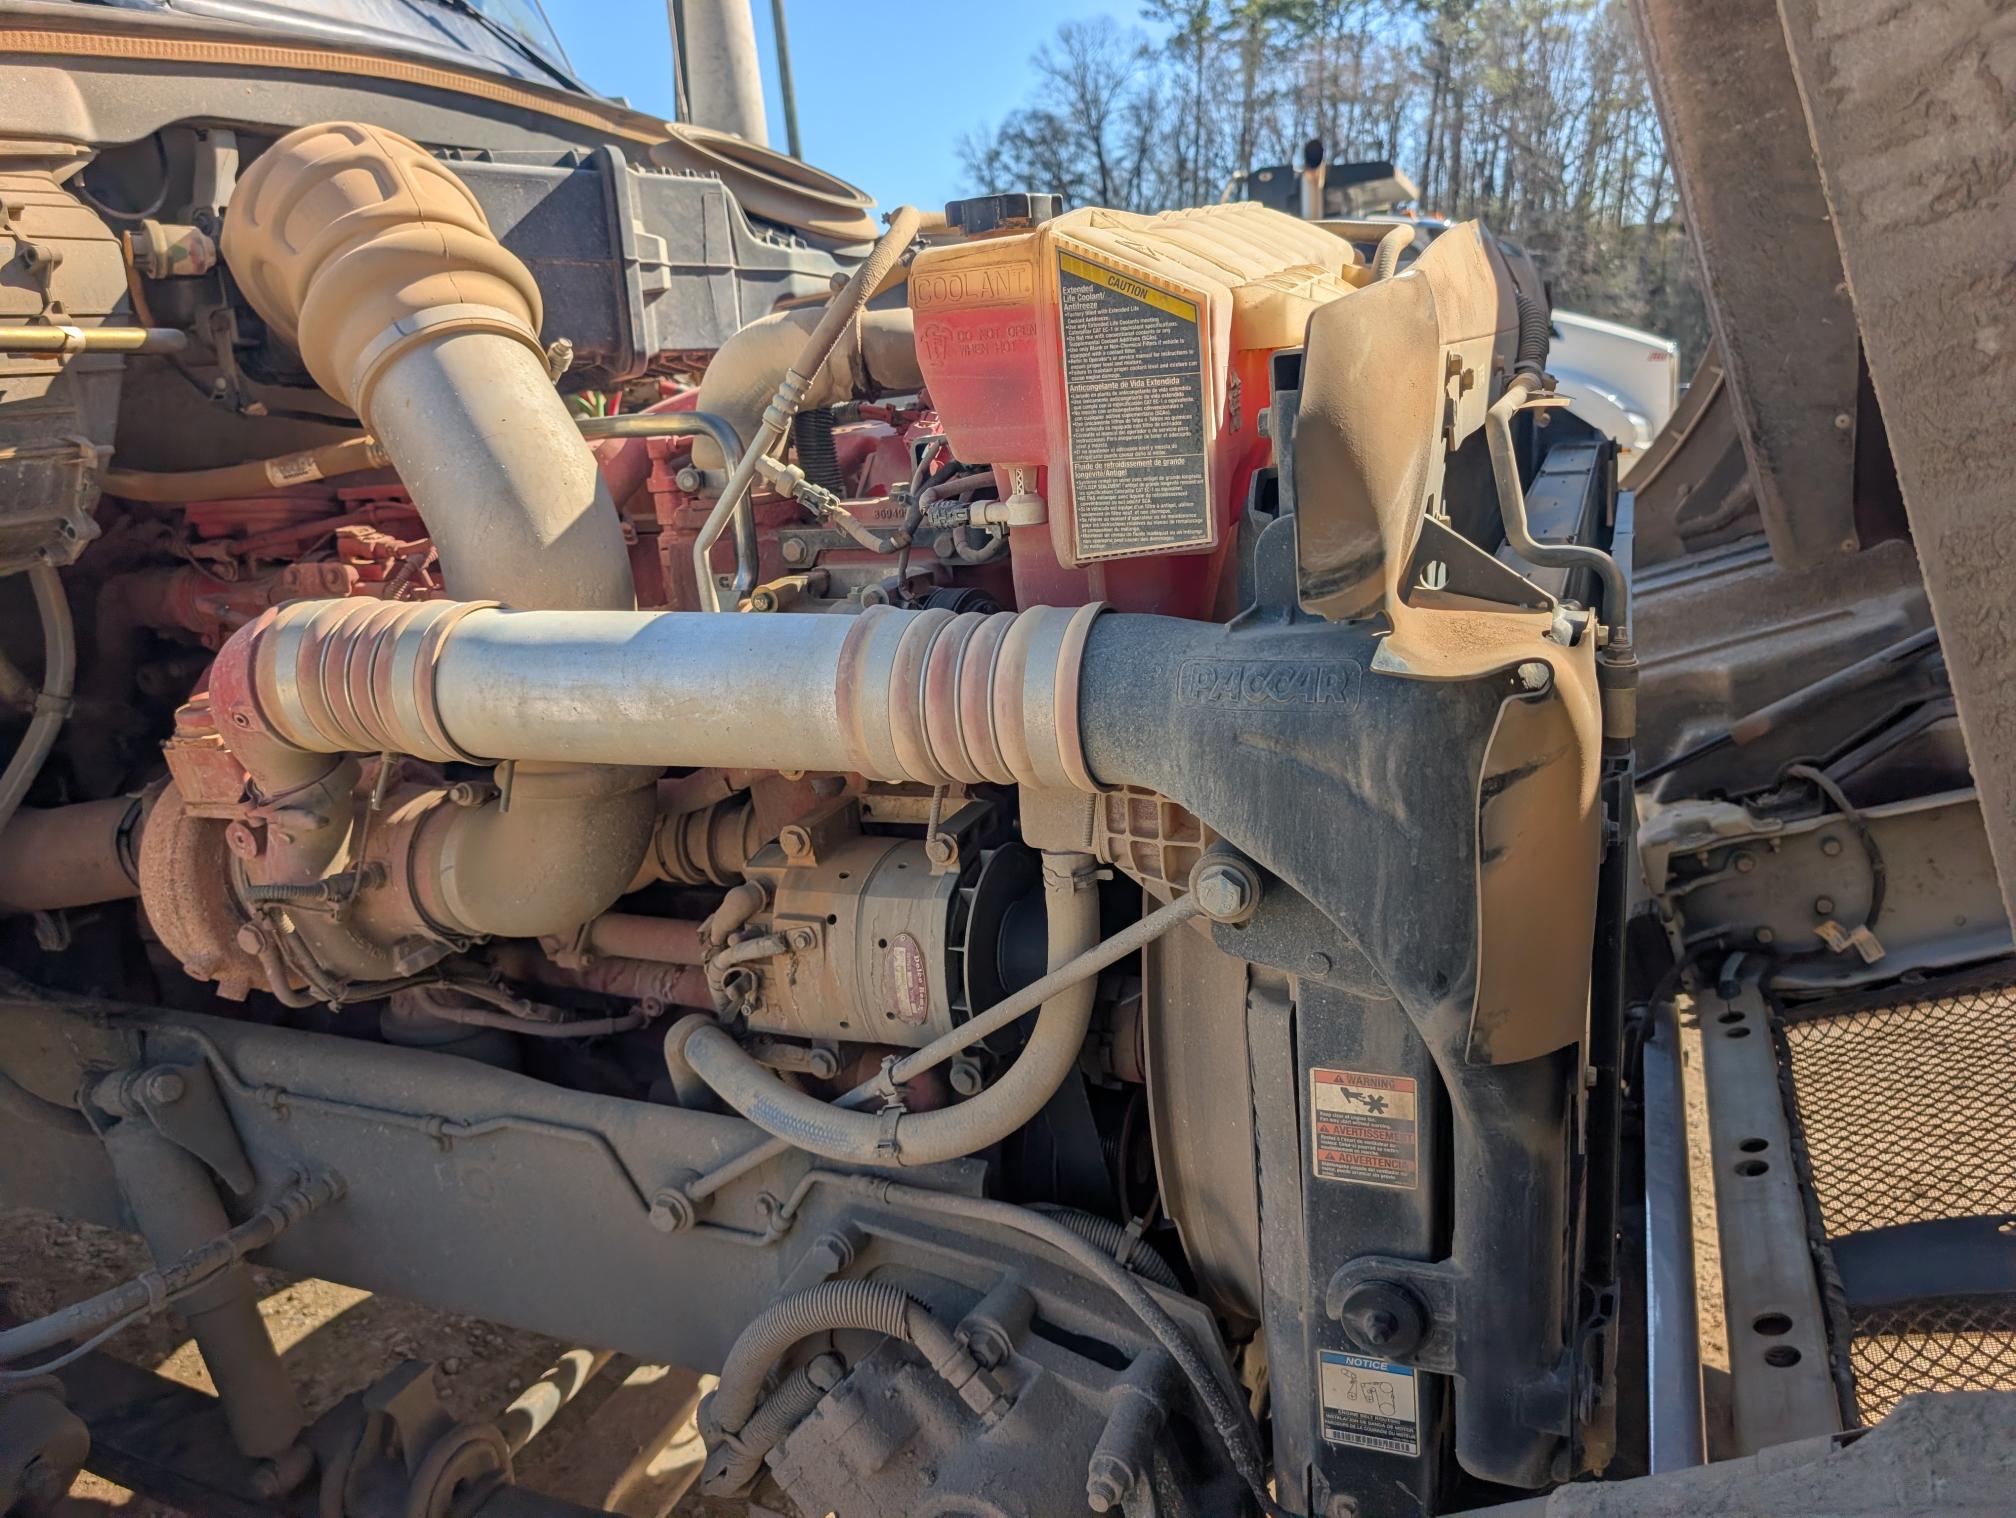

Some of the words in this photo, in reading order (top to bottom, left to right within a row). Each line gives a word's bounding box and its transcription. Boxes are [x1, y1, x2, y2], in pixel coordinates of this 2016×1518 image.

[918, 268, 1025, 304] COOLANT
[1063, 285, 1093, 294] Extended
[1108, 276, 1148, 299] CAUTION
[1064, 294, 1075, 302] Life
[1064, 302, 1097, 311] Antifreeze
[957, 330, 972, 342] DO
[980, 328, 999, 340] NOT
[1008, 324, 1036, 338] OPEN
[960, 344, 988, 355] WHEN
[995, 341, 1015, 352] HOT
[1070, 382, 1118, 392] Anticongelante
[1130, 379, 1144, 387] Vida
[1147, 377, 1179, 386] Extendida
[1191, 662, 1349, 703] PACCAR
[1347, 1076, 1395, 1088] WARNING
[1346, 1357, 1388, 1370] NOTICE
